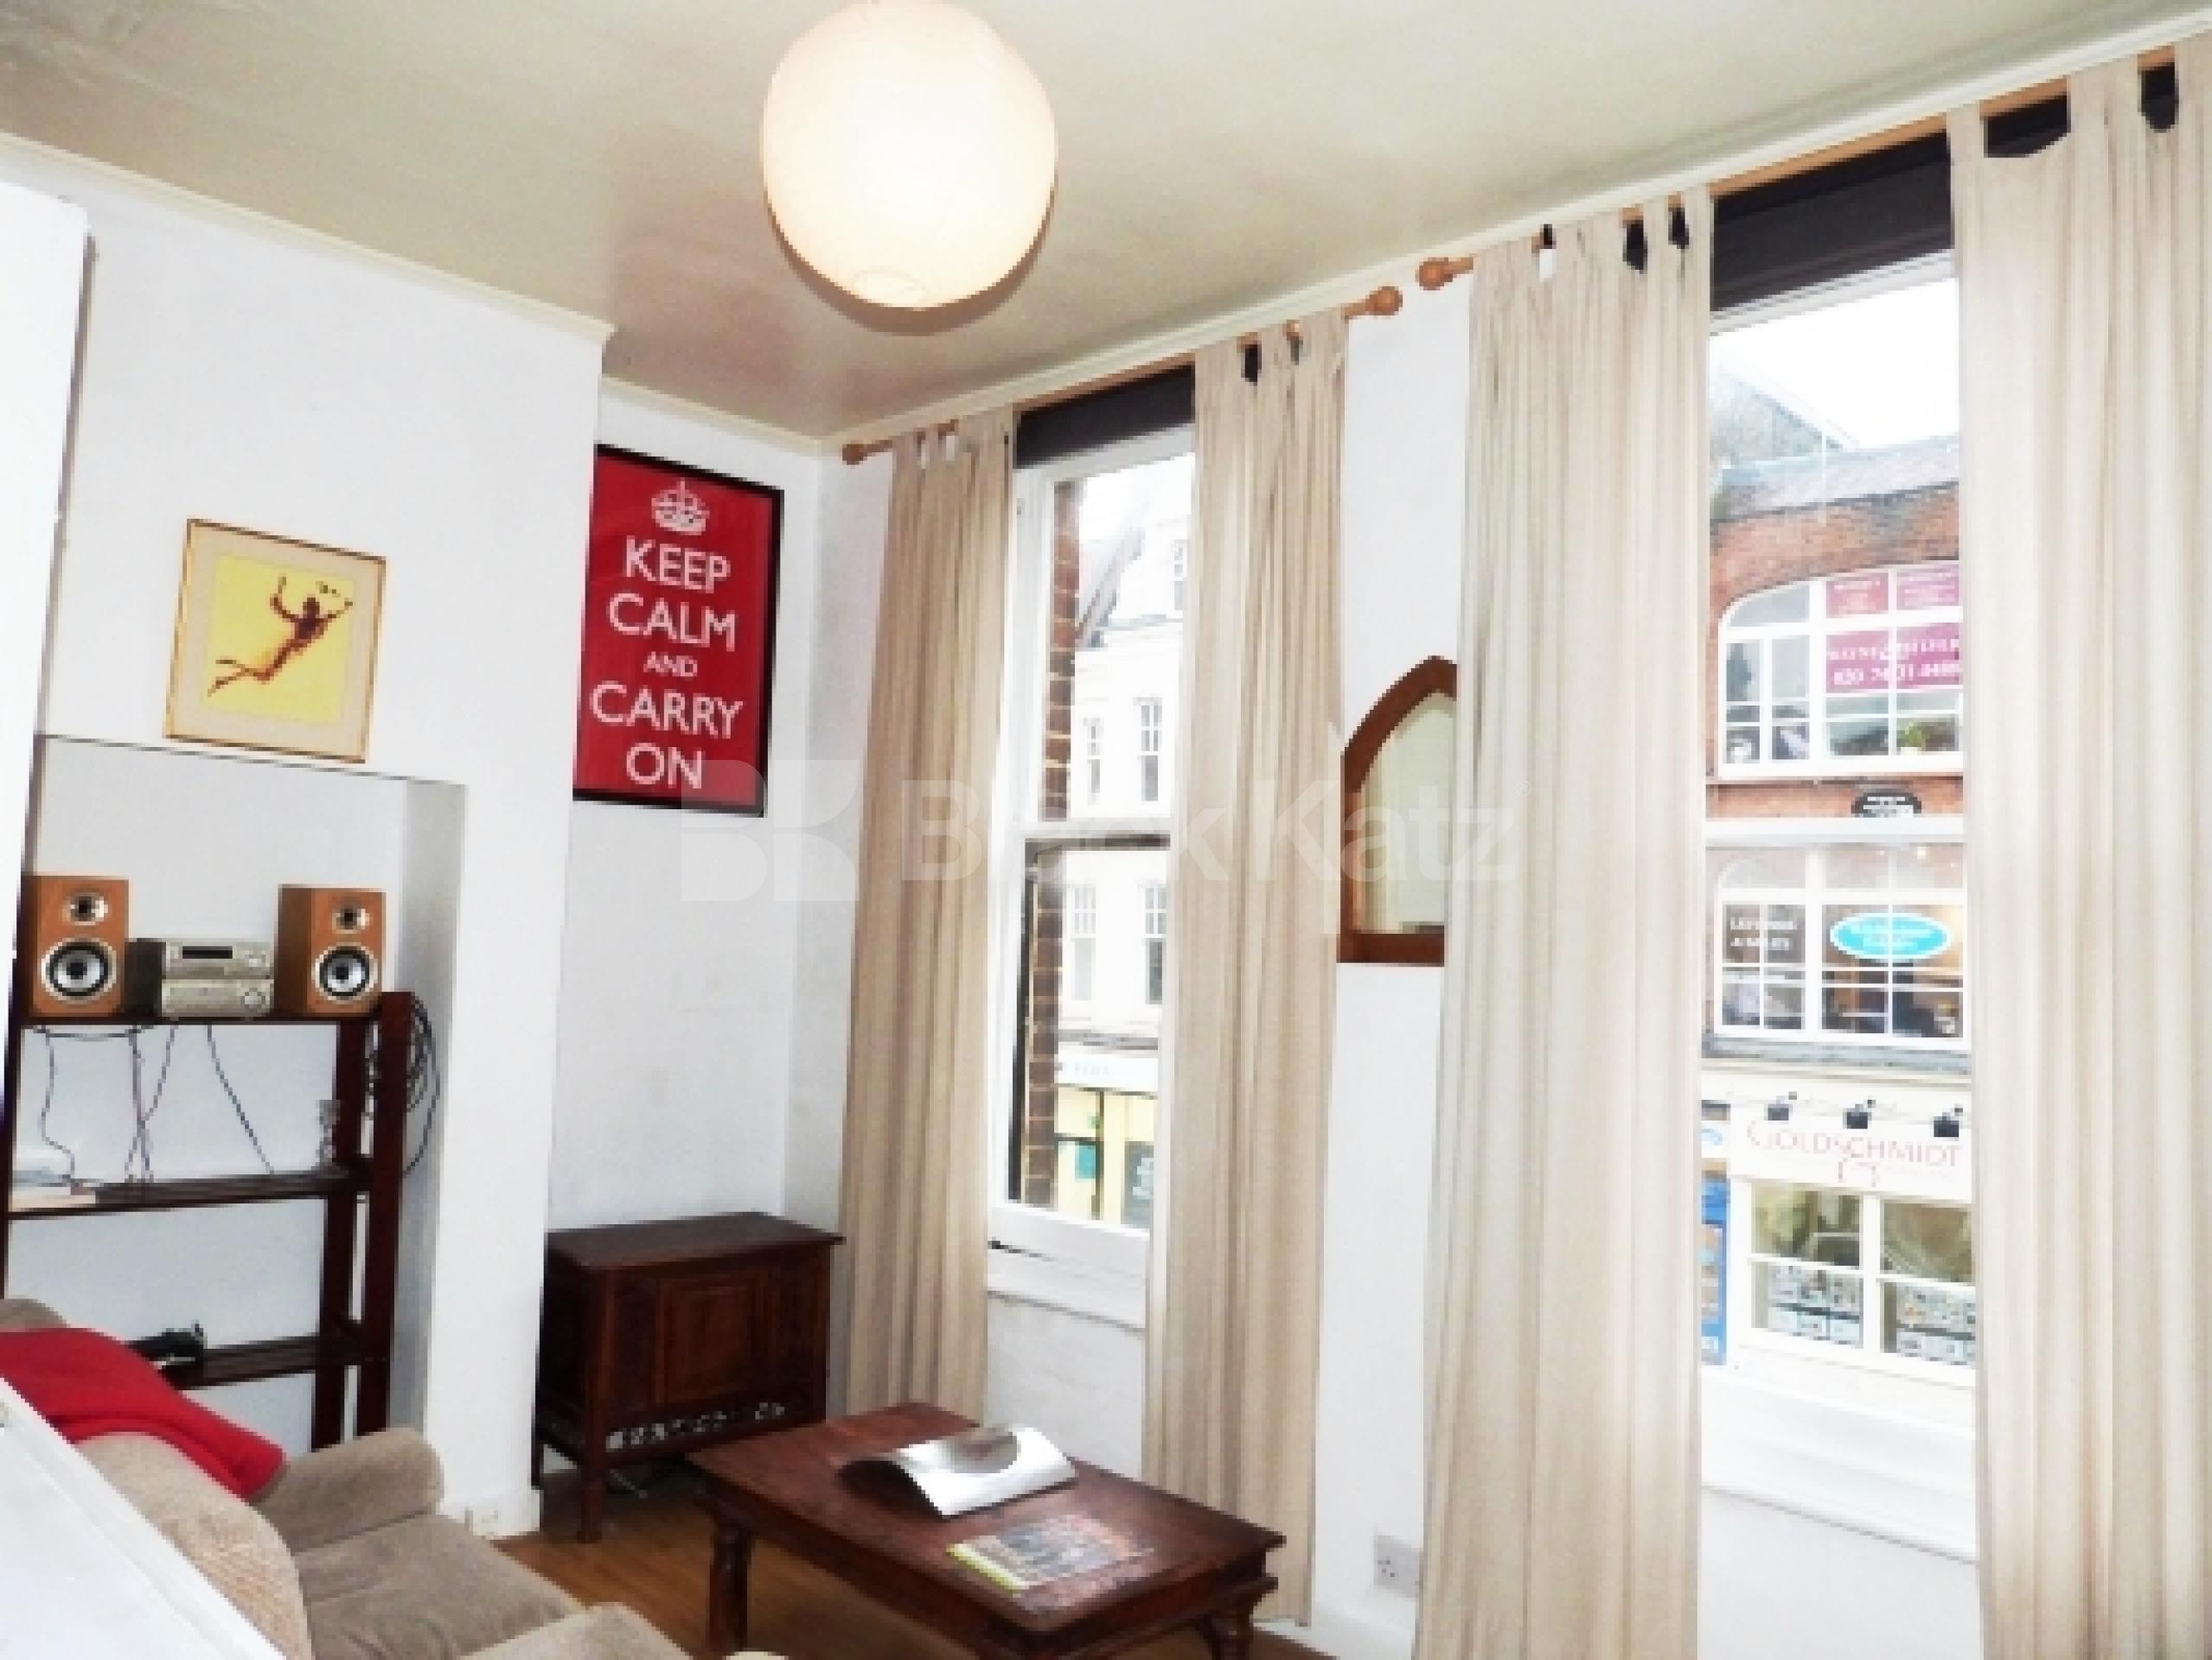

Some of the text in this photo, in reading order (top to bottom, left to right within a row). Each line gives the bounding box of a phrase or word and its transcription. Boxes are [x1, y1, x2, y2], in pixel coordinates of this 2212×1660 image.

[625, 535, 732, 593] KEEP
[609, 592, 736, 652] CALM
[643, 651, 698, 678] AND
[589, 680, 744, 739] CARRY
[625, 743, 703, 789] ON
[1746, 1120, 1963, 1167] GOLDSCHMIDT
